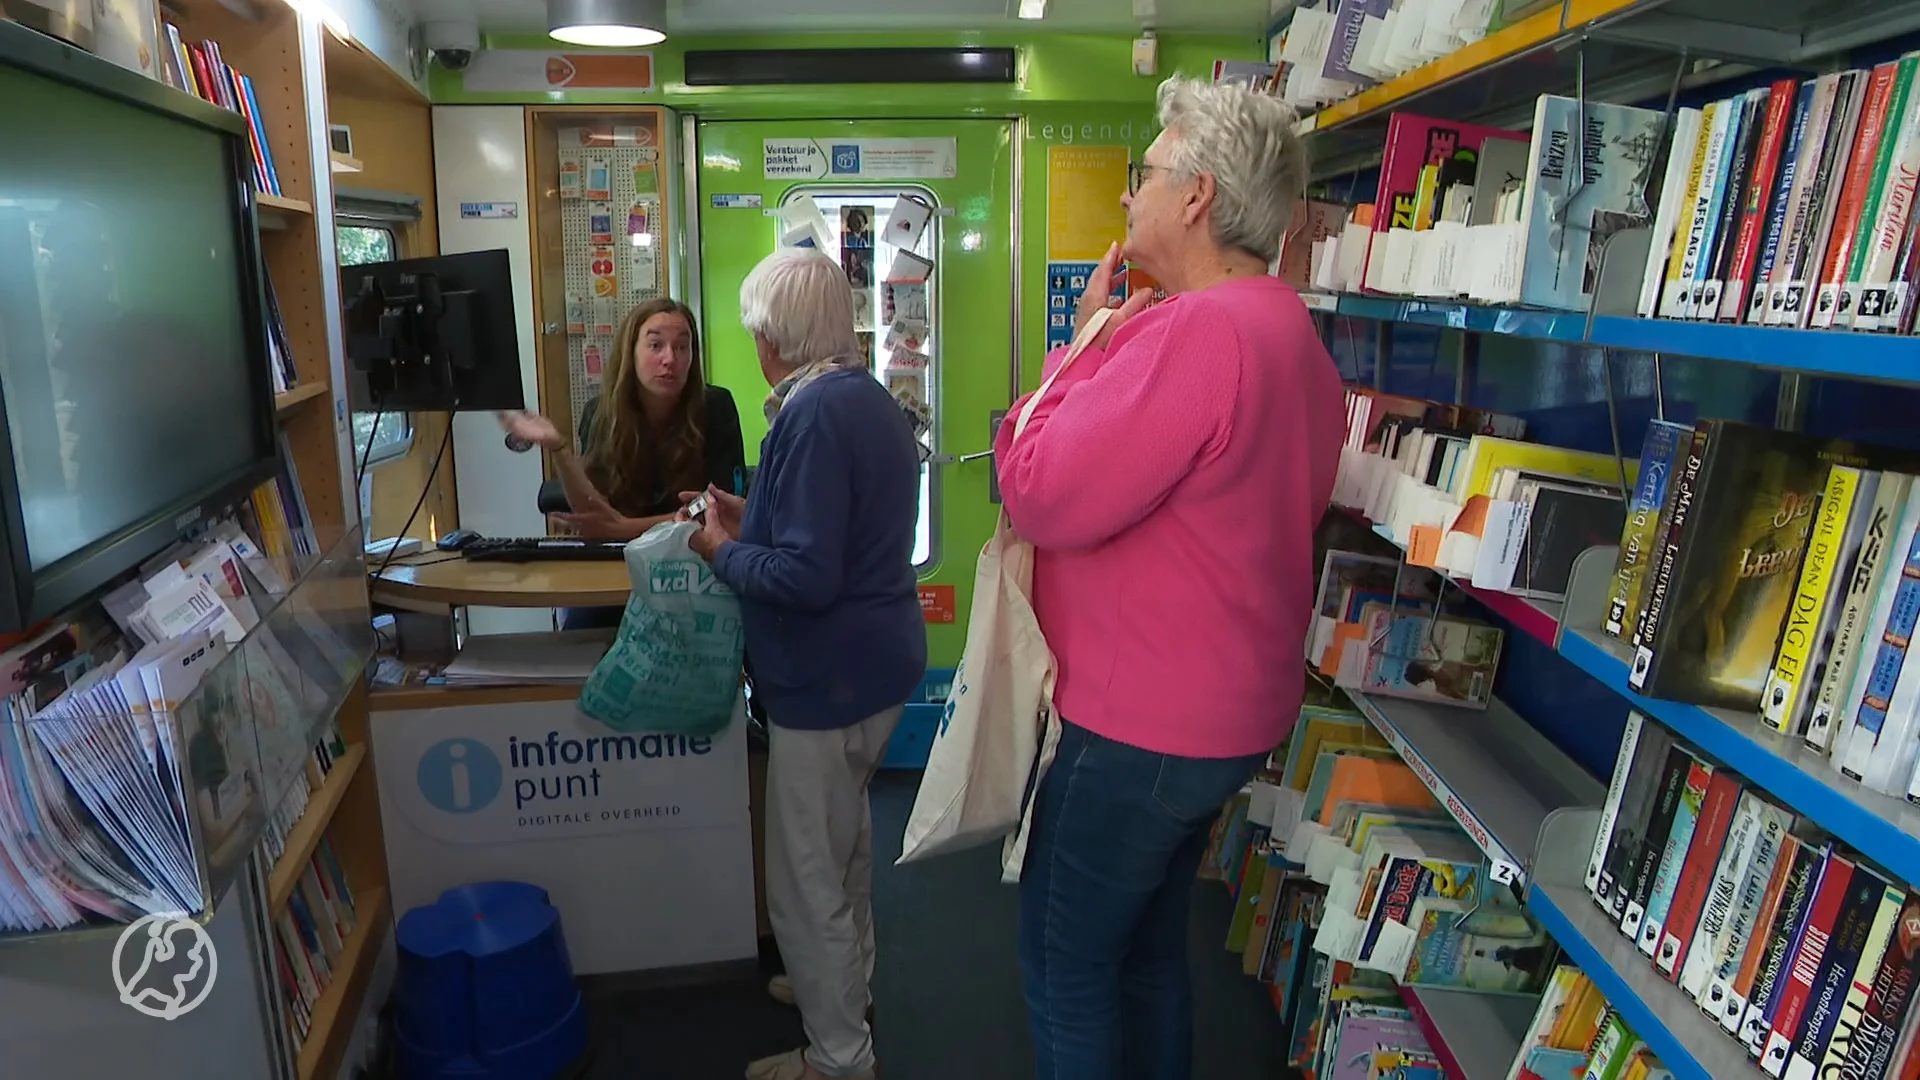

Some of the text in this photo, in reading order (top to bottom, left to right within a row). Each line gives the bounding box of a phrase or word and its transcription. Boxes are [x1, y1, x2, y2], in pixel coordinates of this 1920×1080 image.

[1026, 117, 1151, 144] Legenda
[766, 144, 808, 154] Verstuur
[766, 156, 798, 165] pakket
[1540, 131, 1568, 179] Reizen
[1682, 196, 1709, 279] AFSLAG 23
[1632, 460, 1666, 528] Ketting
[1816, 475, 1847, 541] ABIGAIL
[1625, 532, 1642, 564] van
[1808, 542, 1829, 587] DEAN
[1786, 593, 1817, 647] DAG
[1777, 654, 1800, 682] EE
[509, 731, 712, 768] informatie
[514, 768, 601, 810] punt
[518, 805, 681, 827] DIGITALE OVERHEID
[1447, 795, 1489, 849] RESERVERINGEN
[1768, 821, 1778, 839] DE
[1756, 838, 1776, 866] KUIL
[1387, 864, 1421, 904] Duck
[1745, 874, 1760, 909] LAURA
[1703, 874, 1735, 940] SWINGERS
[1736, 909, 1751, 935] VAN
[1728, 934, 1741, 960] DER
[1718, 956, 1732, 981] HAA
[1828, 962, 1847, 986] Het
[1873, 963, 1896, 1001] HEITZ
[1882, 966, 1912, 1019] MARKUS
